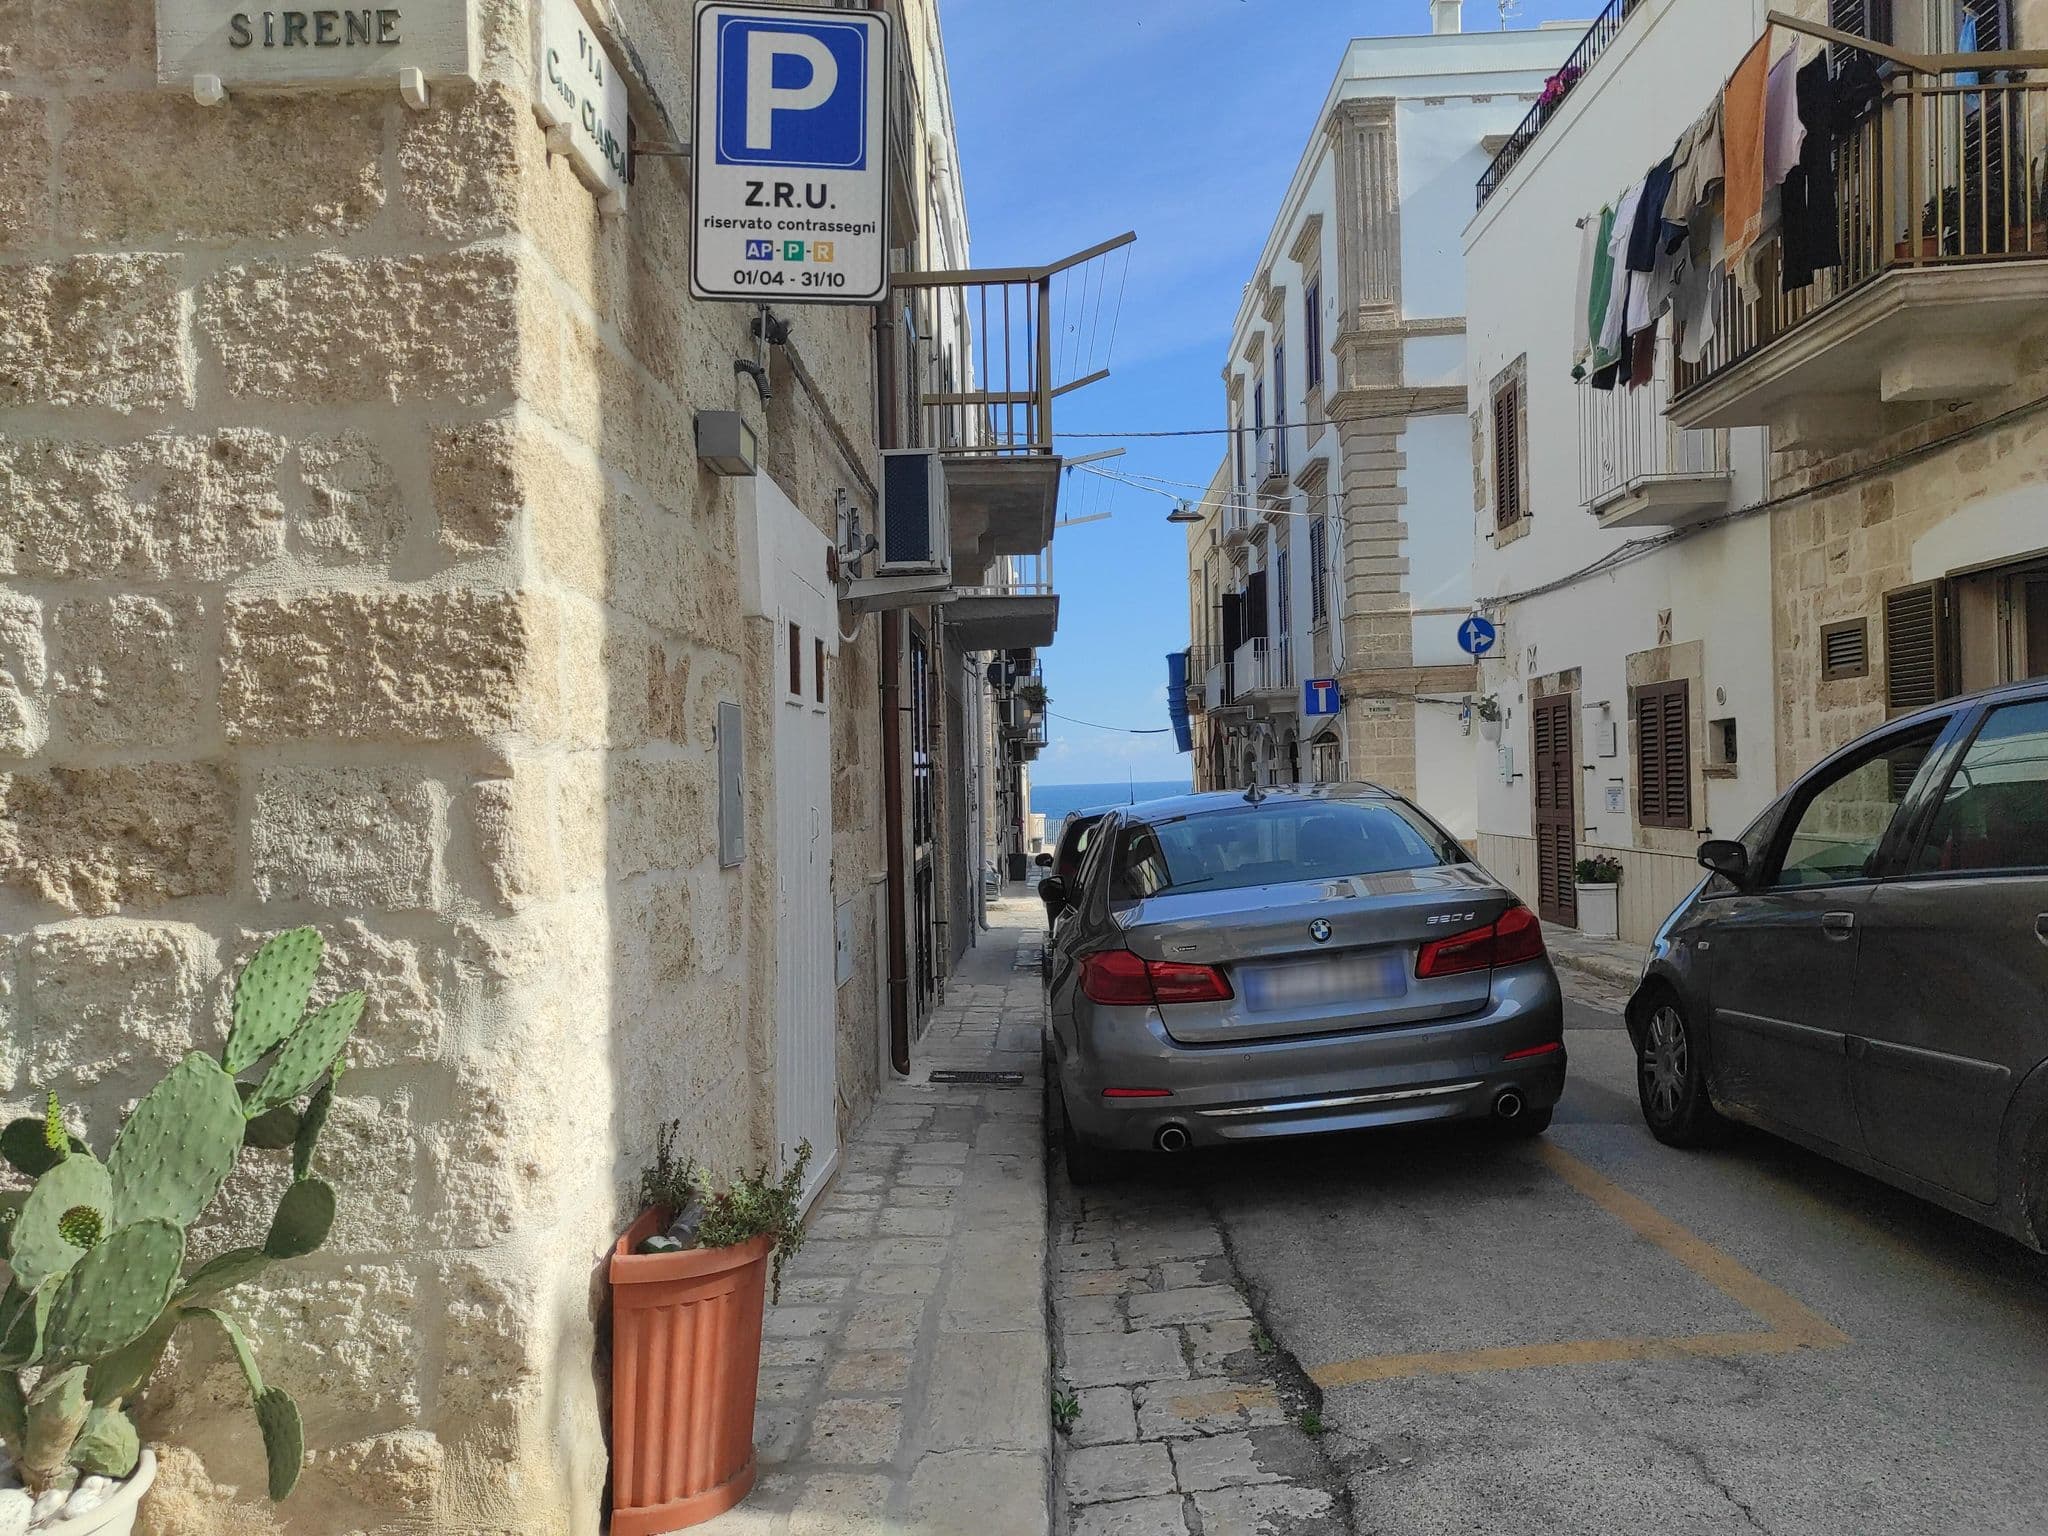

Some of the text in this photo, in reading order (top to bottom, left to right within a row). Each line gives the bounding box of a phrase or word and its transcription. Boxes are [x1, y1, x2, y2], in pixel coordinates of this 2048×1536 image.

[228, 8, 402, 48] SIRENE
[578, 29, 603, 87] VIA
[745, 30, 838, 150] P
[744, 180, 836, 210] Z.R.U.
[704, 215, 876, 236] riservato contrassegni
[747, 242, 773, 258] AP
[788, 243, 800, 259] P
[817, 245, 830, 260] R
[733, 269, 785, 286] 01/04
[801, 271, 846, 288] 31/10
